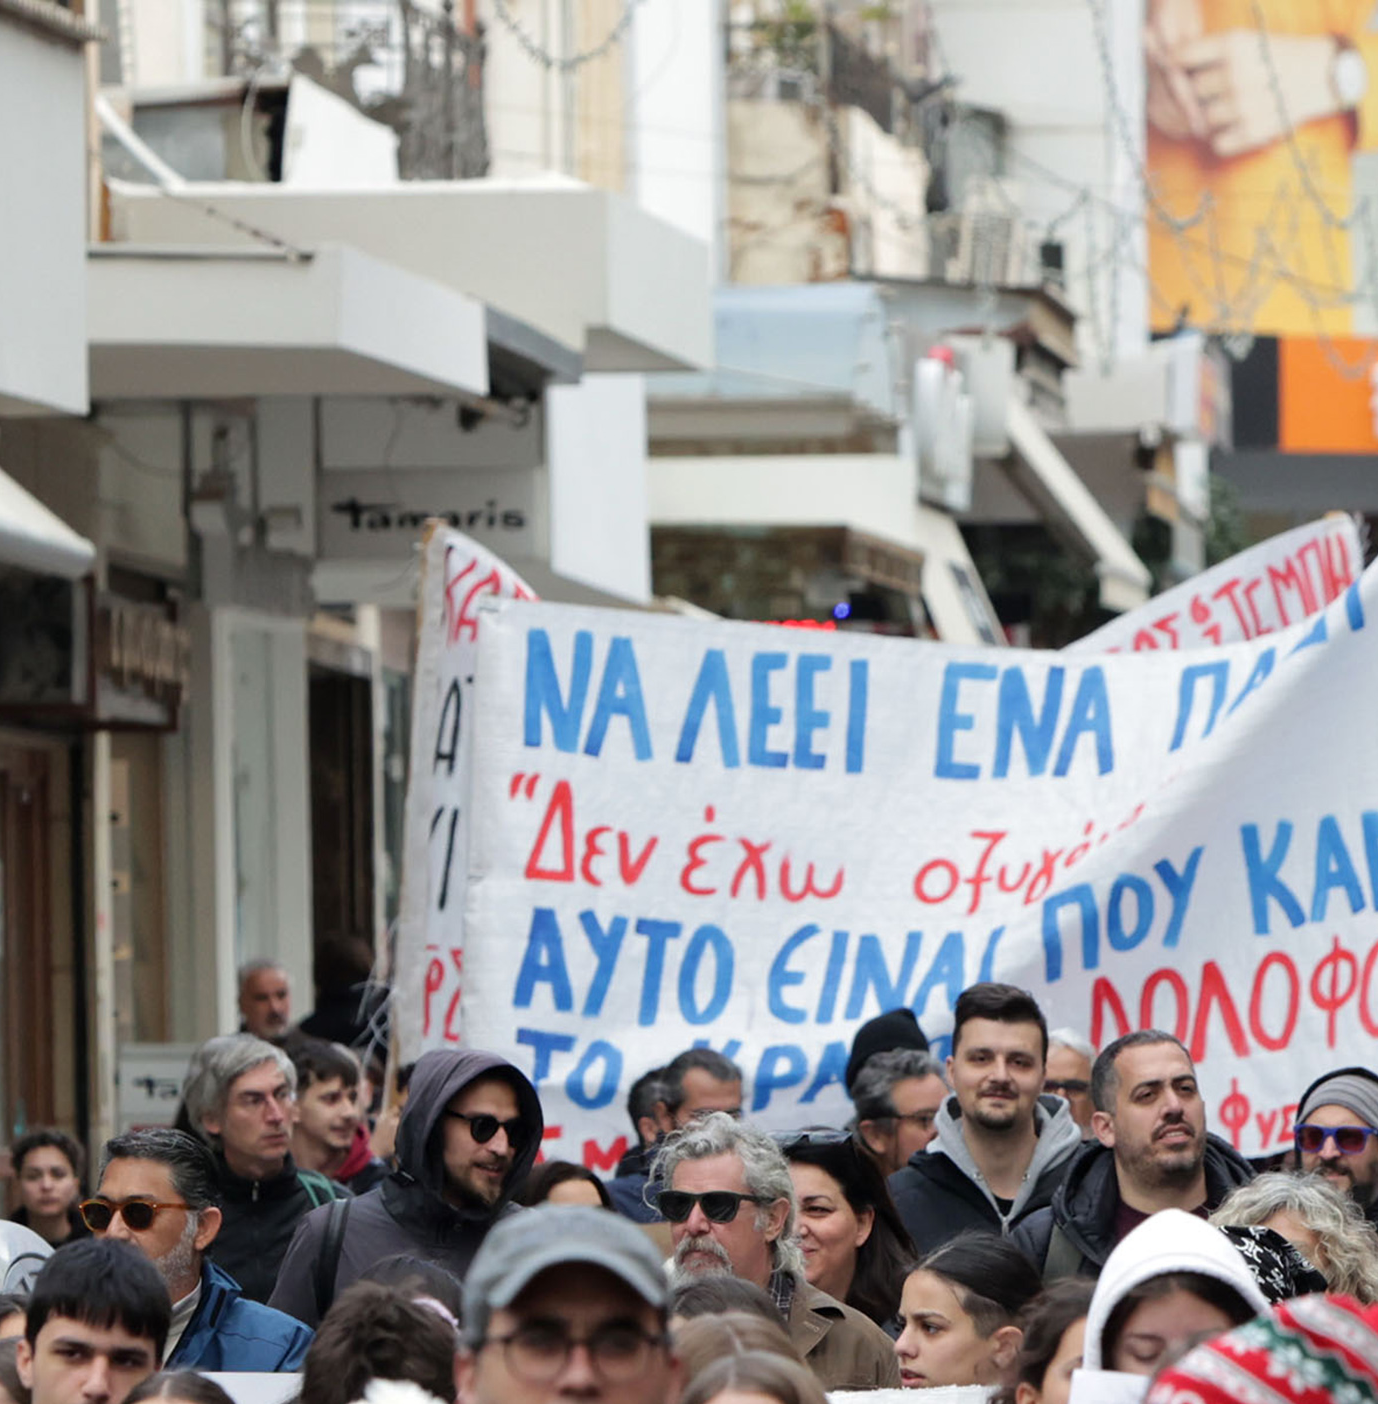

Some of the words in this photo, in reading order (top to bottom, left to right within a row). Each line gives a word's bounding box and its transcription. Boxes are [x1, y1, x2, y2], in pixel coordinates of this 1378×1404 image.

[523, 626, 654, 762] ΝΑ
[674, 646, 869, 774] ΛΕΕΙ
[933, 660, 1115, 781] ΕΝΑ
[512, 907, 735, 1027] ΑΥΤΟ
[1042, 845, 1206, 984] ΠΟΥ
[515, 1028, 623, 1111] ΤΟ
